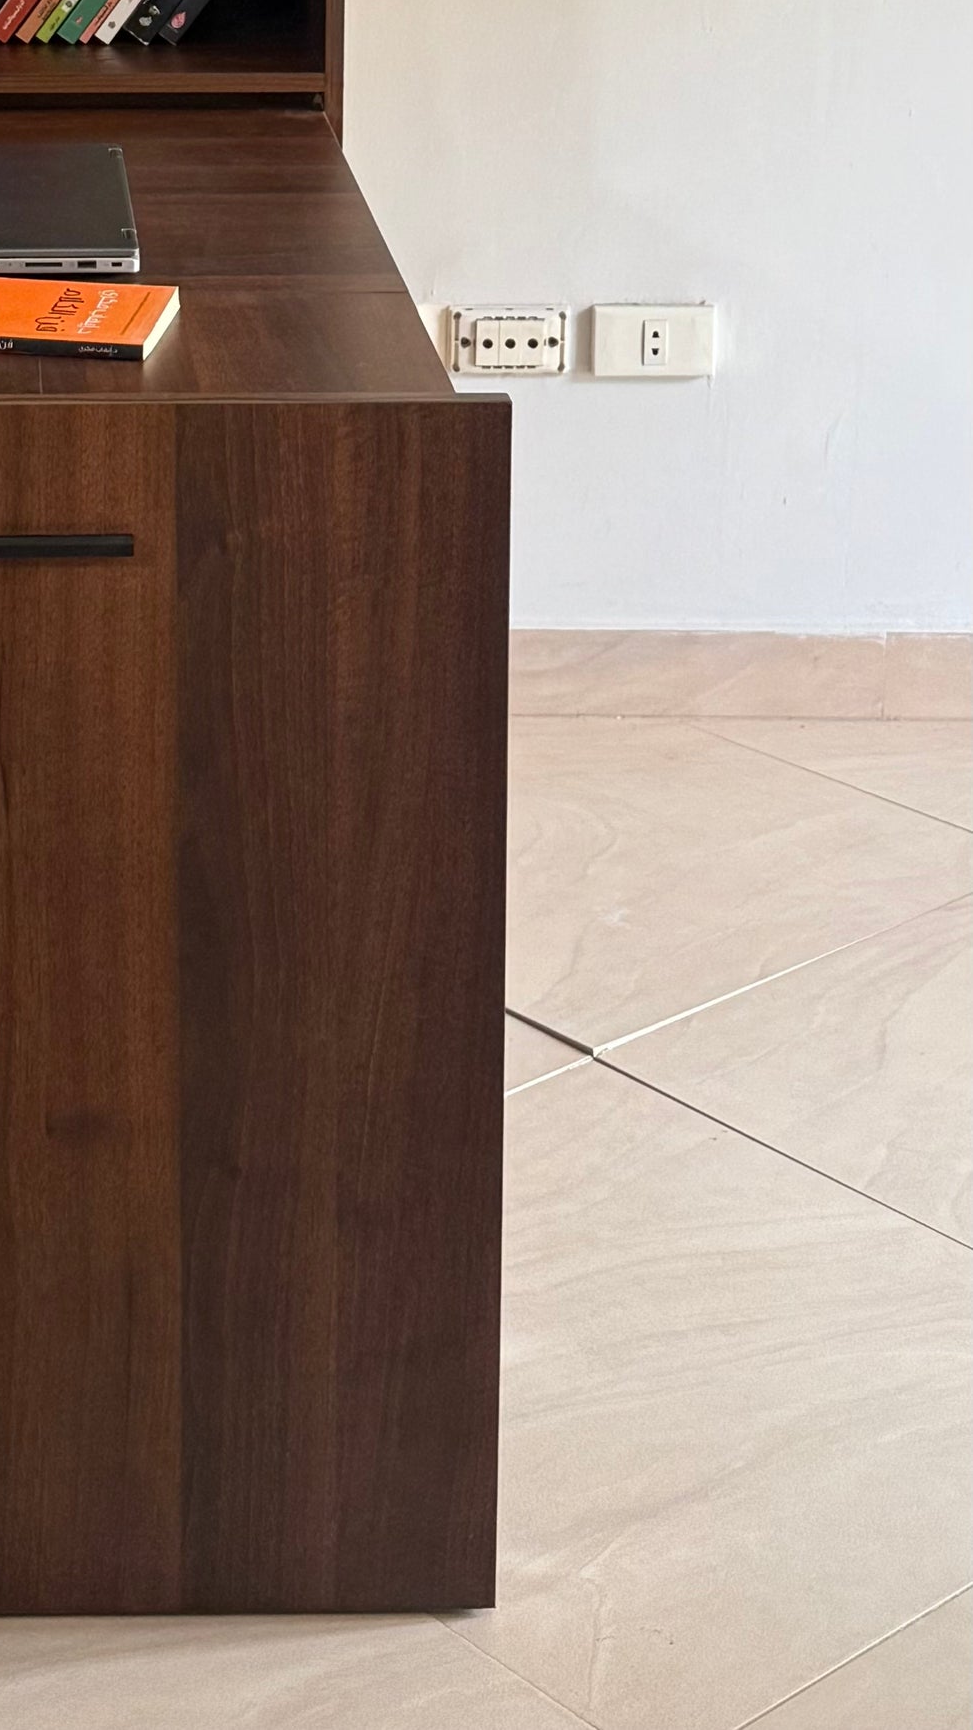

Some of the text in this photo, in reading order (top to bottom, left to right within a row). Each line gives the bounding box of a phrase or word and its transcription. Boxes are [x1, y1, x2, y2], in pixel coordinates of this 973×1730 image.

[35, 288, 84, 332] فن الكلام
[0, 339, 13, 350] فن
